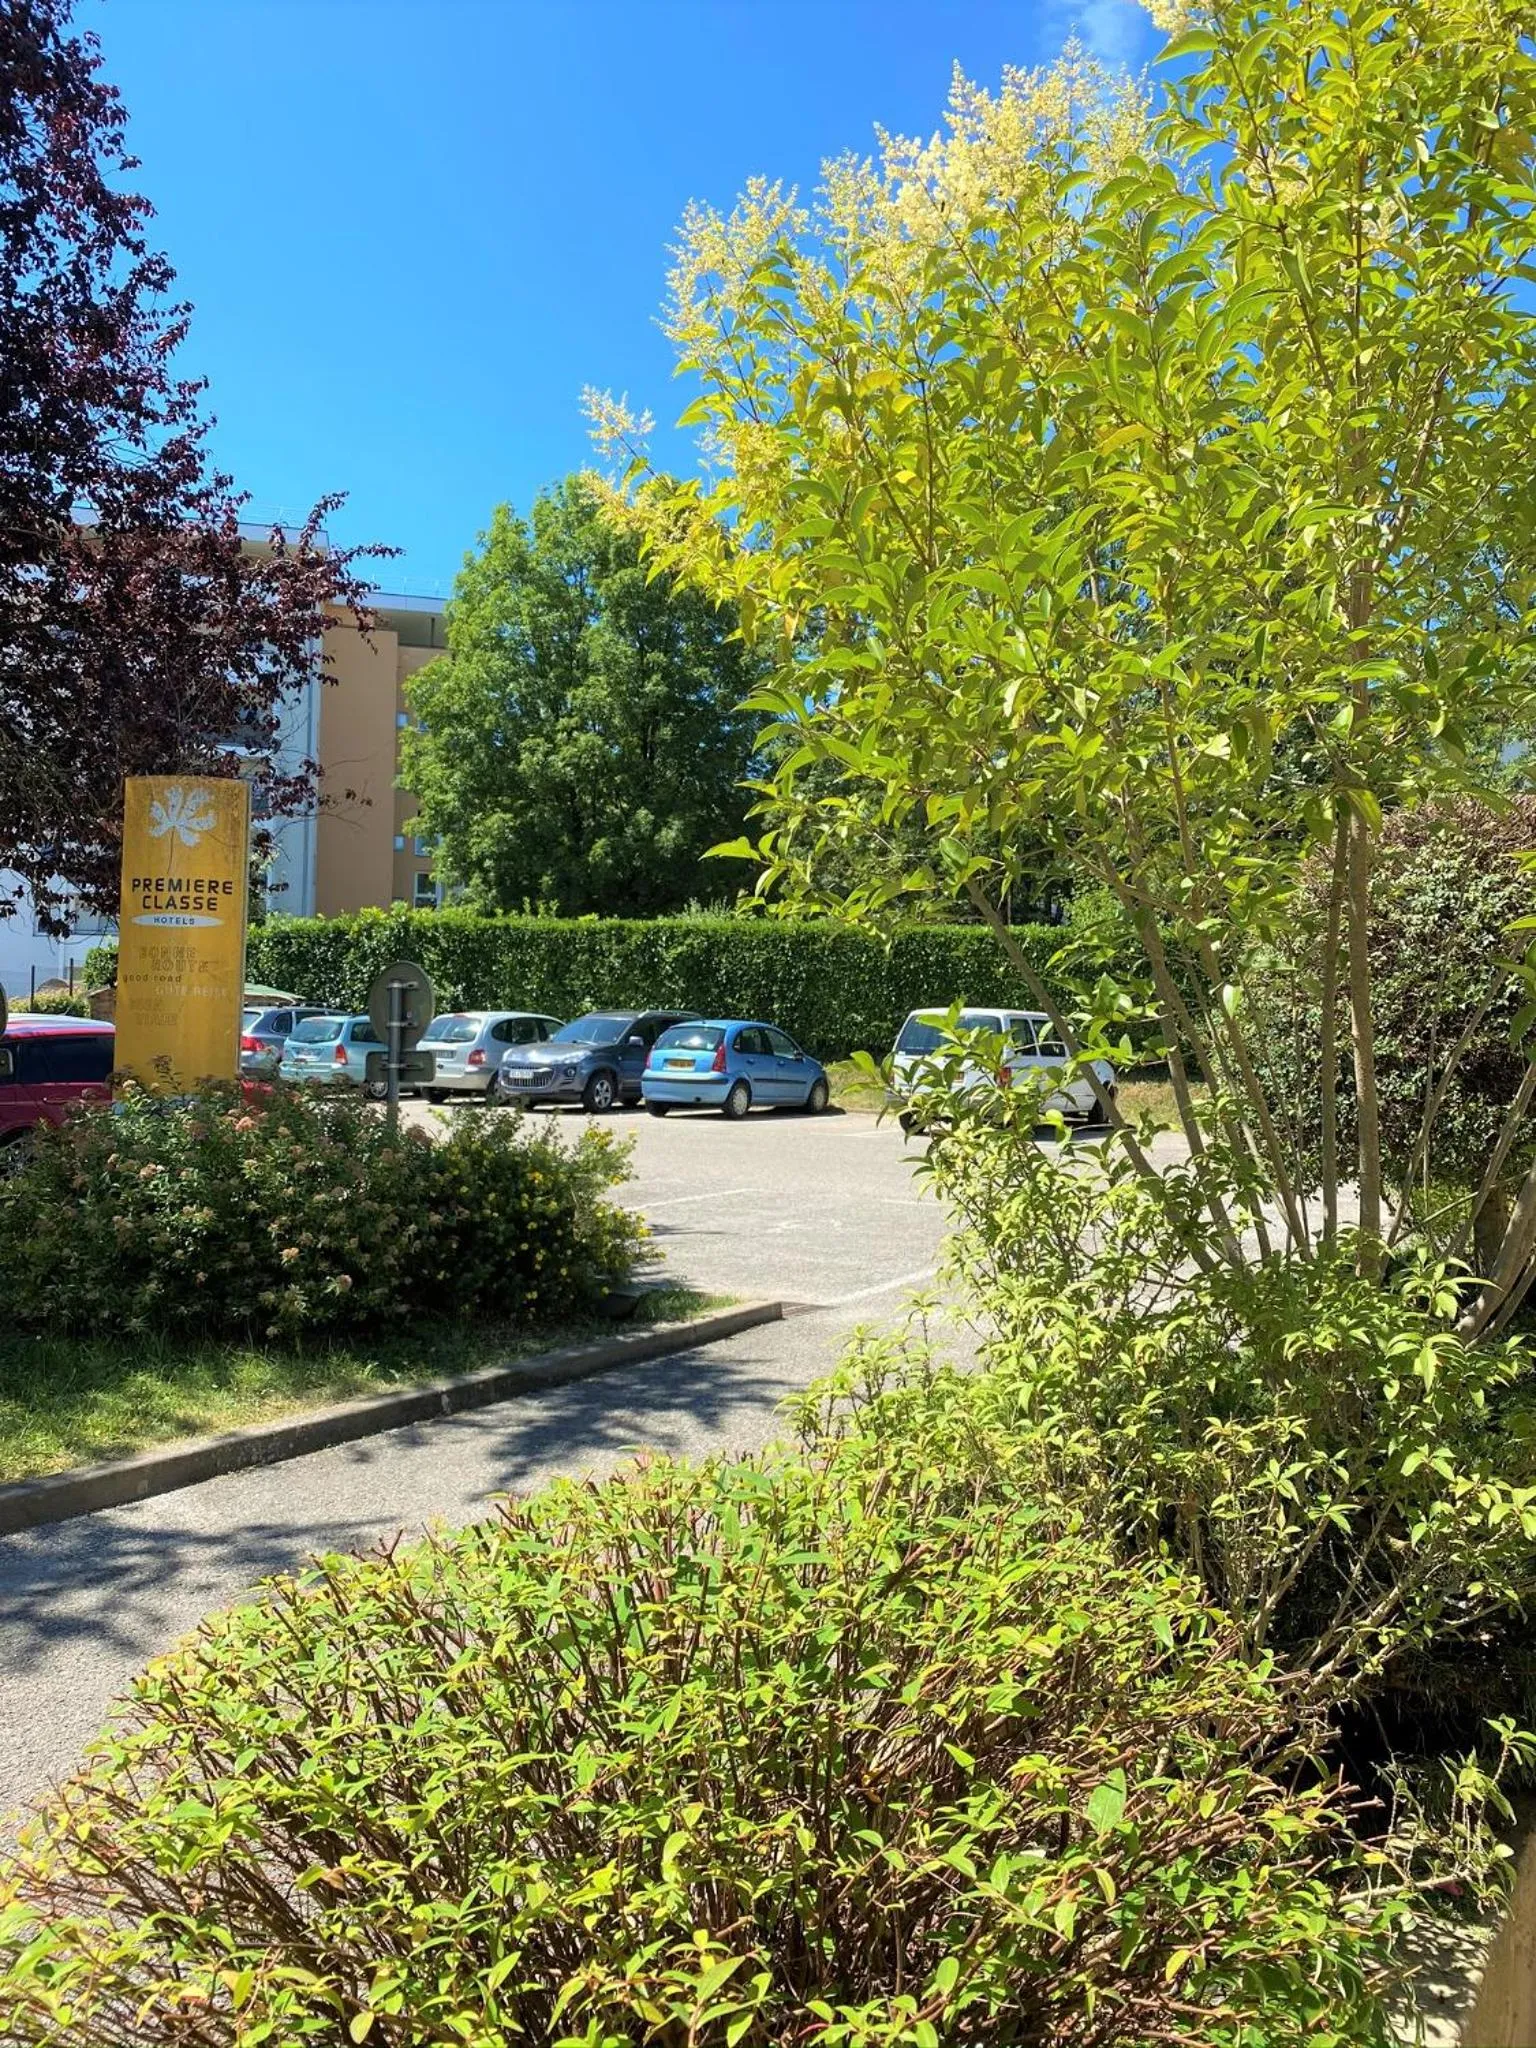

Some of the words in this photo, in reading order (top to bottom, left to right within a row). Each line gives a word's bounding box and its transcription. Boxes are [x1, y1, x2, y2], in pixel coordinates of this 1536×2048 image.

[131, 877, 233, 895] PREMIERE
[142, 895, 218, 911] CLASSE
[153, 916, 195, 925] HOTELS
